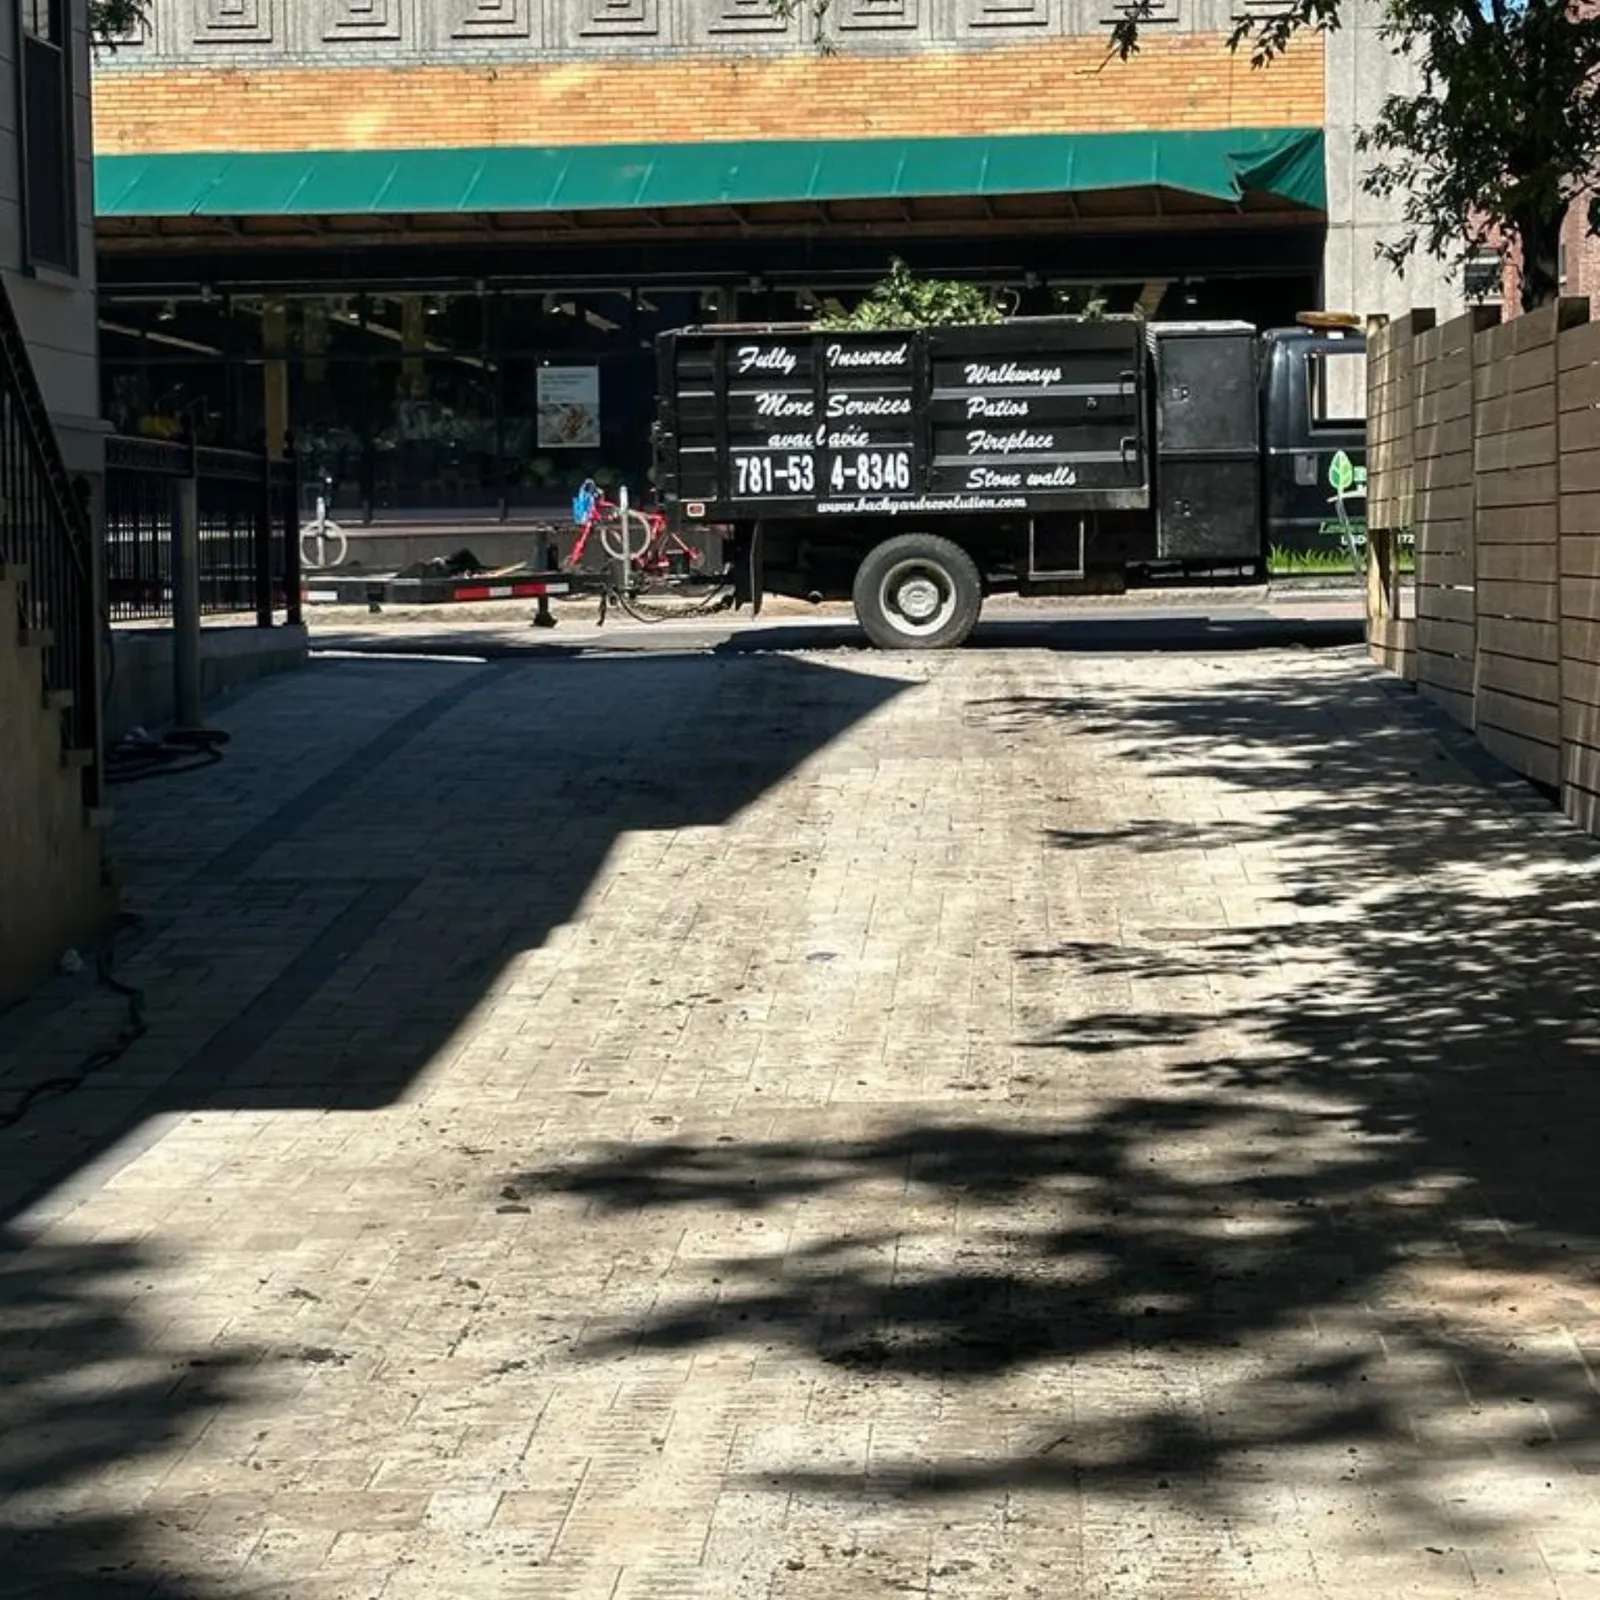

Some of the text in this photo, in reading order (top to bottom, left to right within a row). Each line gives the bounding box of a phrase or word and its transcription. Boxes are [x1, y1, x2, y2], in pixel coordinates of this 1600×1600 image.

[737, 343, 908, 375] Fully Insured
[964, 362, 1062, 387] Walkways
[756, 393, 912, 418] More Services
[966, 396, 1029, 420] Patios
[966, 429, 1054, 455] Fireplace
[966, 466, 1077, 489] Stone walls
[817, 494, 1028, 515] www.backyardrevolution.com
